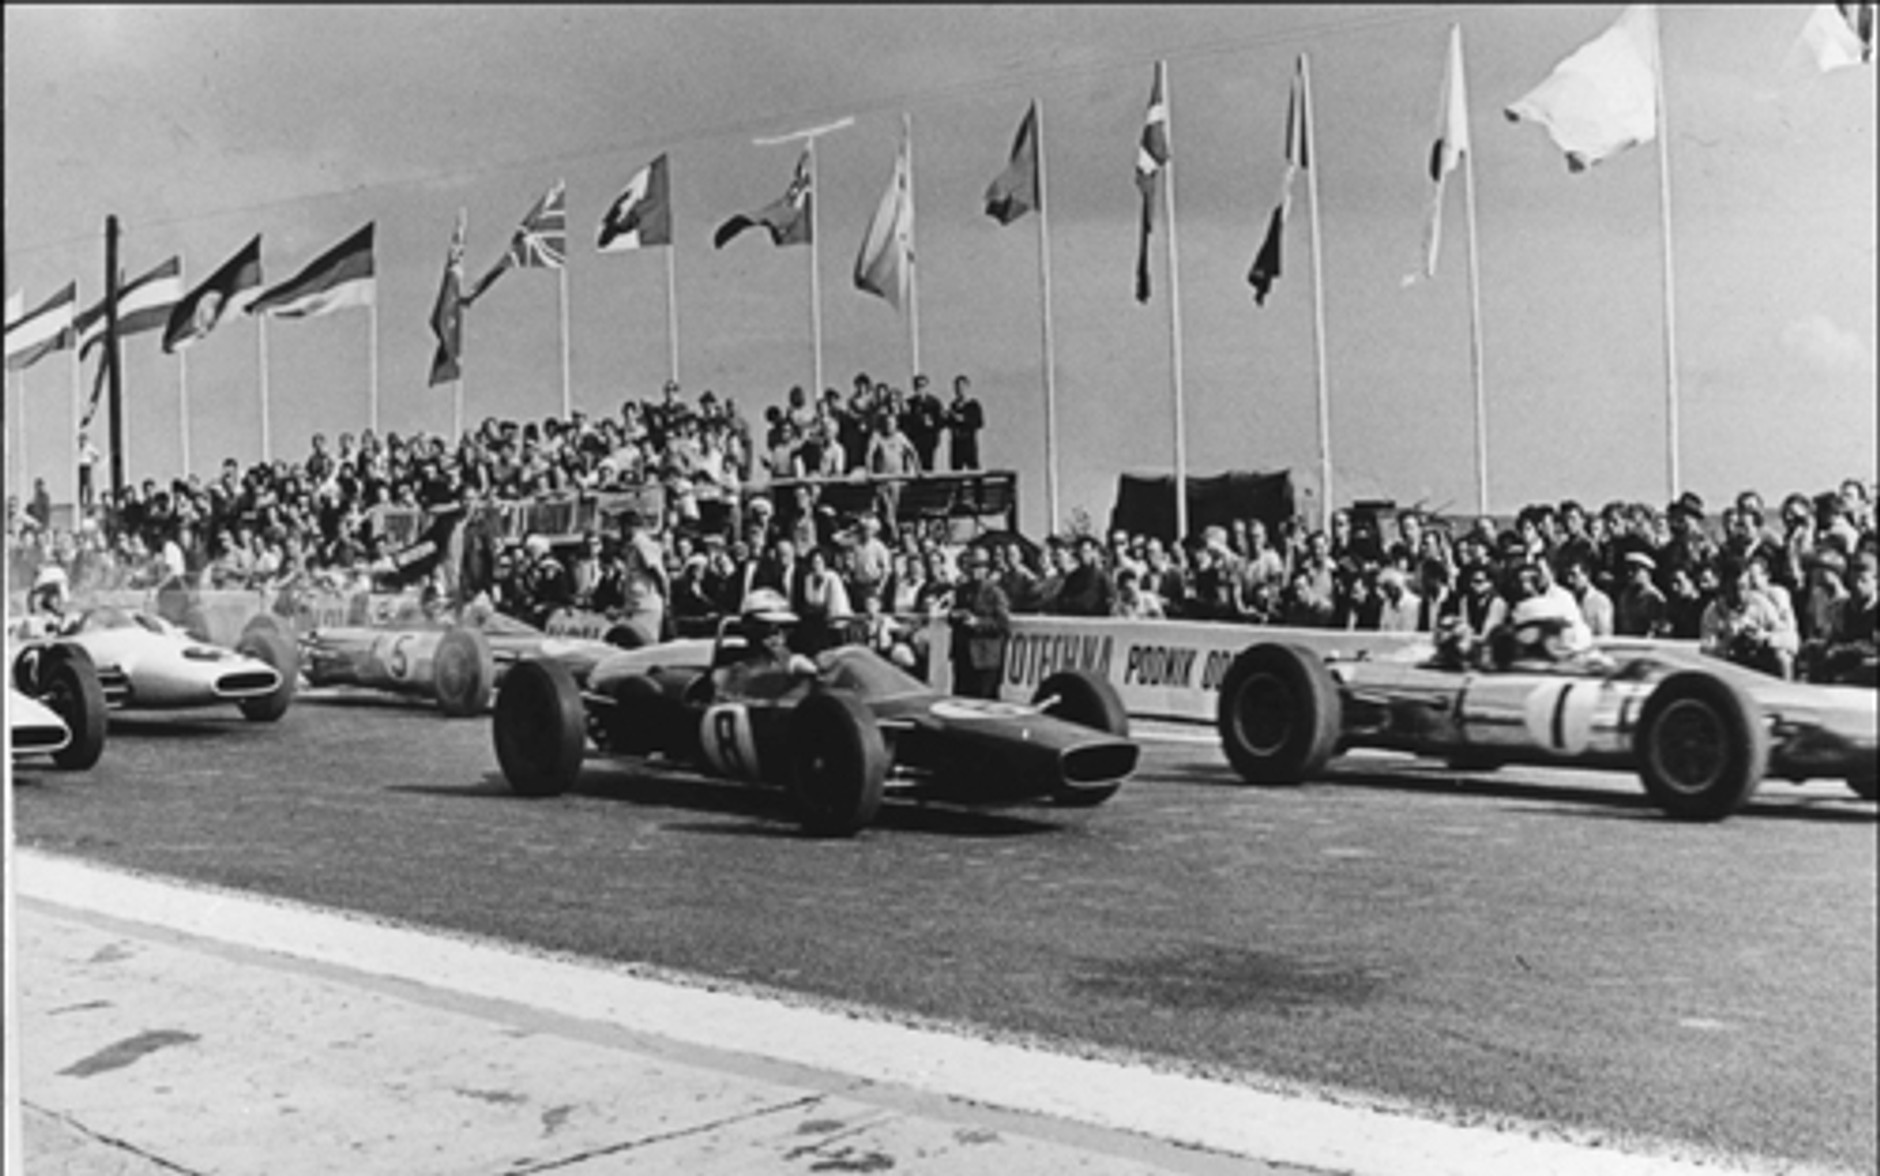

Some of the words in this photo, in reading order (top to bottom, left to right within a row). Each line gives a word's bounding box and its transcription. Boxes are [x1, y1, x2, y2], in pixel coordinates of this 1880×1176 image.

[1008, 632, 1114, 686] OTECHNA
[1124, 645, 1198, 688] PODNIK
[1553, 683, 1574, 749] 1
